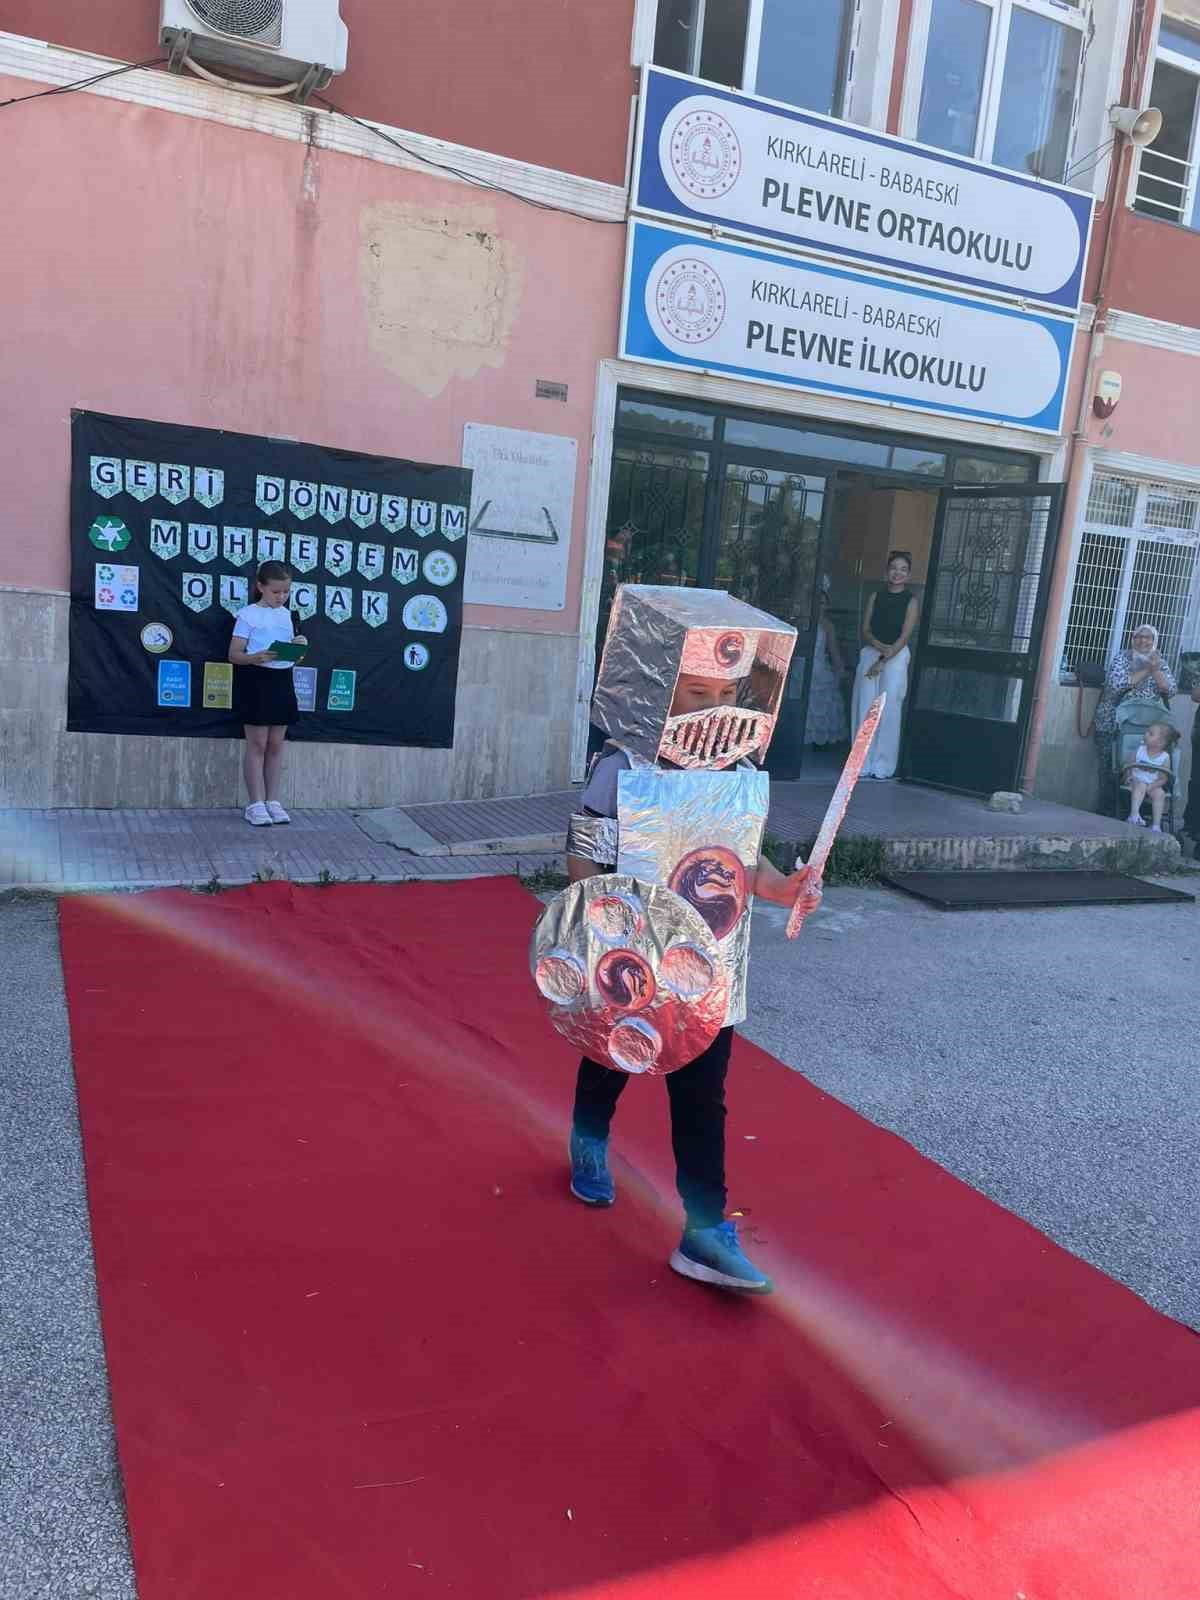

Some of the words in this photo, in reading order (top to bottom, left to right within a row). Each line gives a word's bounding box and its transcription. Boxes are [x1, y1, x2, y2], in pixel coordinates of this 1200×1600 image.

[767, 135, 866, 181] KIRKLARELİ
[880, 167, 959, 206] BABAESKİ
[761, 177, 871, 233] PLEVNE
[877, 208, 1033, 271] ORTAOKULU
[751, 279, 849, 319] KIRKLARELİ
[863, 304, 942, 338] BABAESKİ
[746, 320, 854, 368] PLEVNE
[859, 337, 986, 392] İLKOKULU
[96, 462, 213, 496] GERİ
[264, 482, 464, 528] DÖNÜŞÜM
[154, 525, 416, 572] MUHTEŞEM
[187, 578, 380, 615] OLCAK
